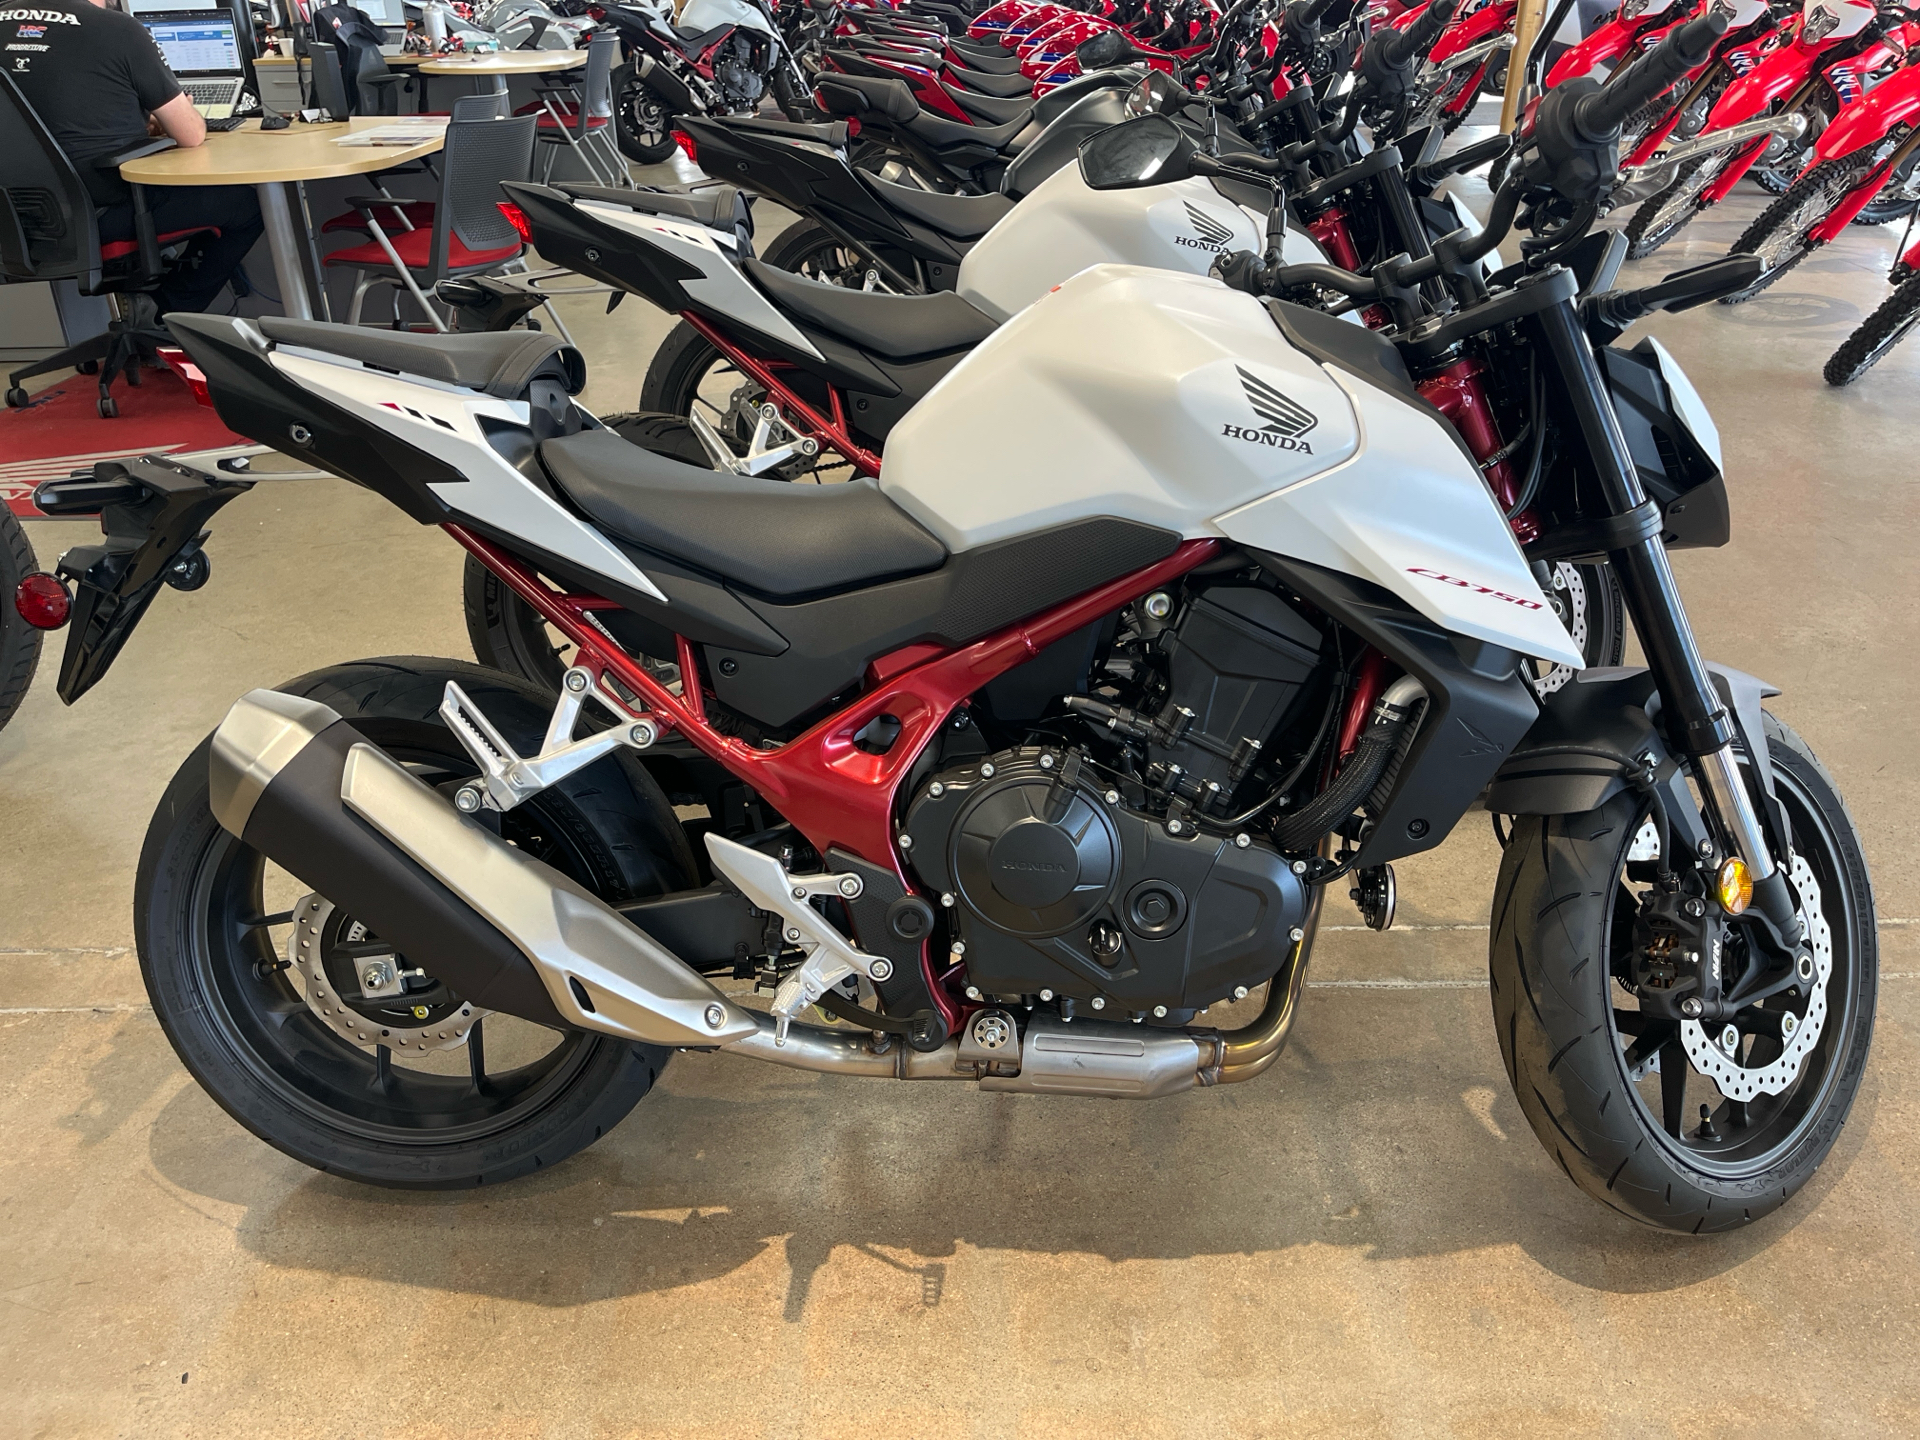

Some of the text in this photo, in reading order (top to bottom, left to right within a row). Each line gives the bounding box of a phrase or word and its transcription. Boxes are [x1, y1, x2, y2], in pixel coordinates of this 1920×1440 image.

[0, 9, 81, 26] HONDA
[1174, 235, 1233, 257] HONDA
[1221, 423, 1314, 456] HONDA
[1405, 567, 1543, 610] CB750
[1002, 860, 1067, 873] HONDA
[1712, 938, 1720, 980] NISSIN
